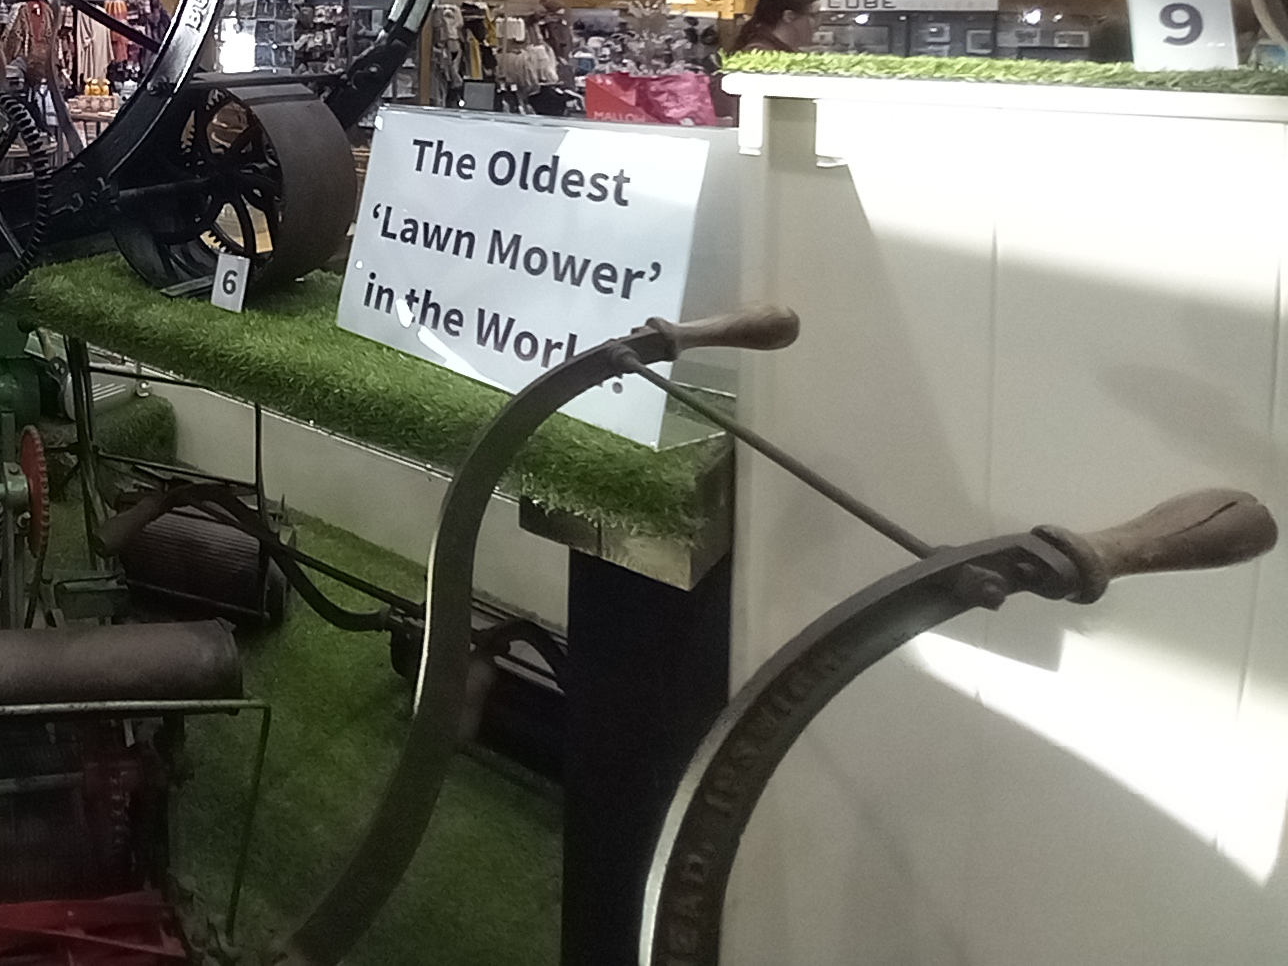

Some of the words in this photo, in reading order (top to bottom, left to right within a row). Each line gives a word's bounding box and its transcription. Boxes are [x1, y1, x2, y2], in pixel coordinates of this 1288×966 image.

[1158, 1, 1204, 45] 9
[412, 139, 477, 180] The
[486, 150, 631, 207] Oldest
[222, 270, 239, 295] 6
[372, 202, 477, 260] ‘Lawn
[486, 228, 662, 300] Mower’
[363, 272, 396, 314] in
[404, 288, 464, 337] the
